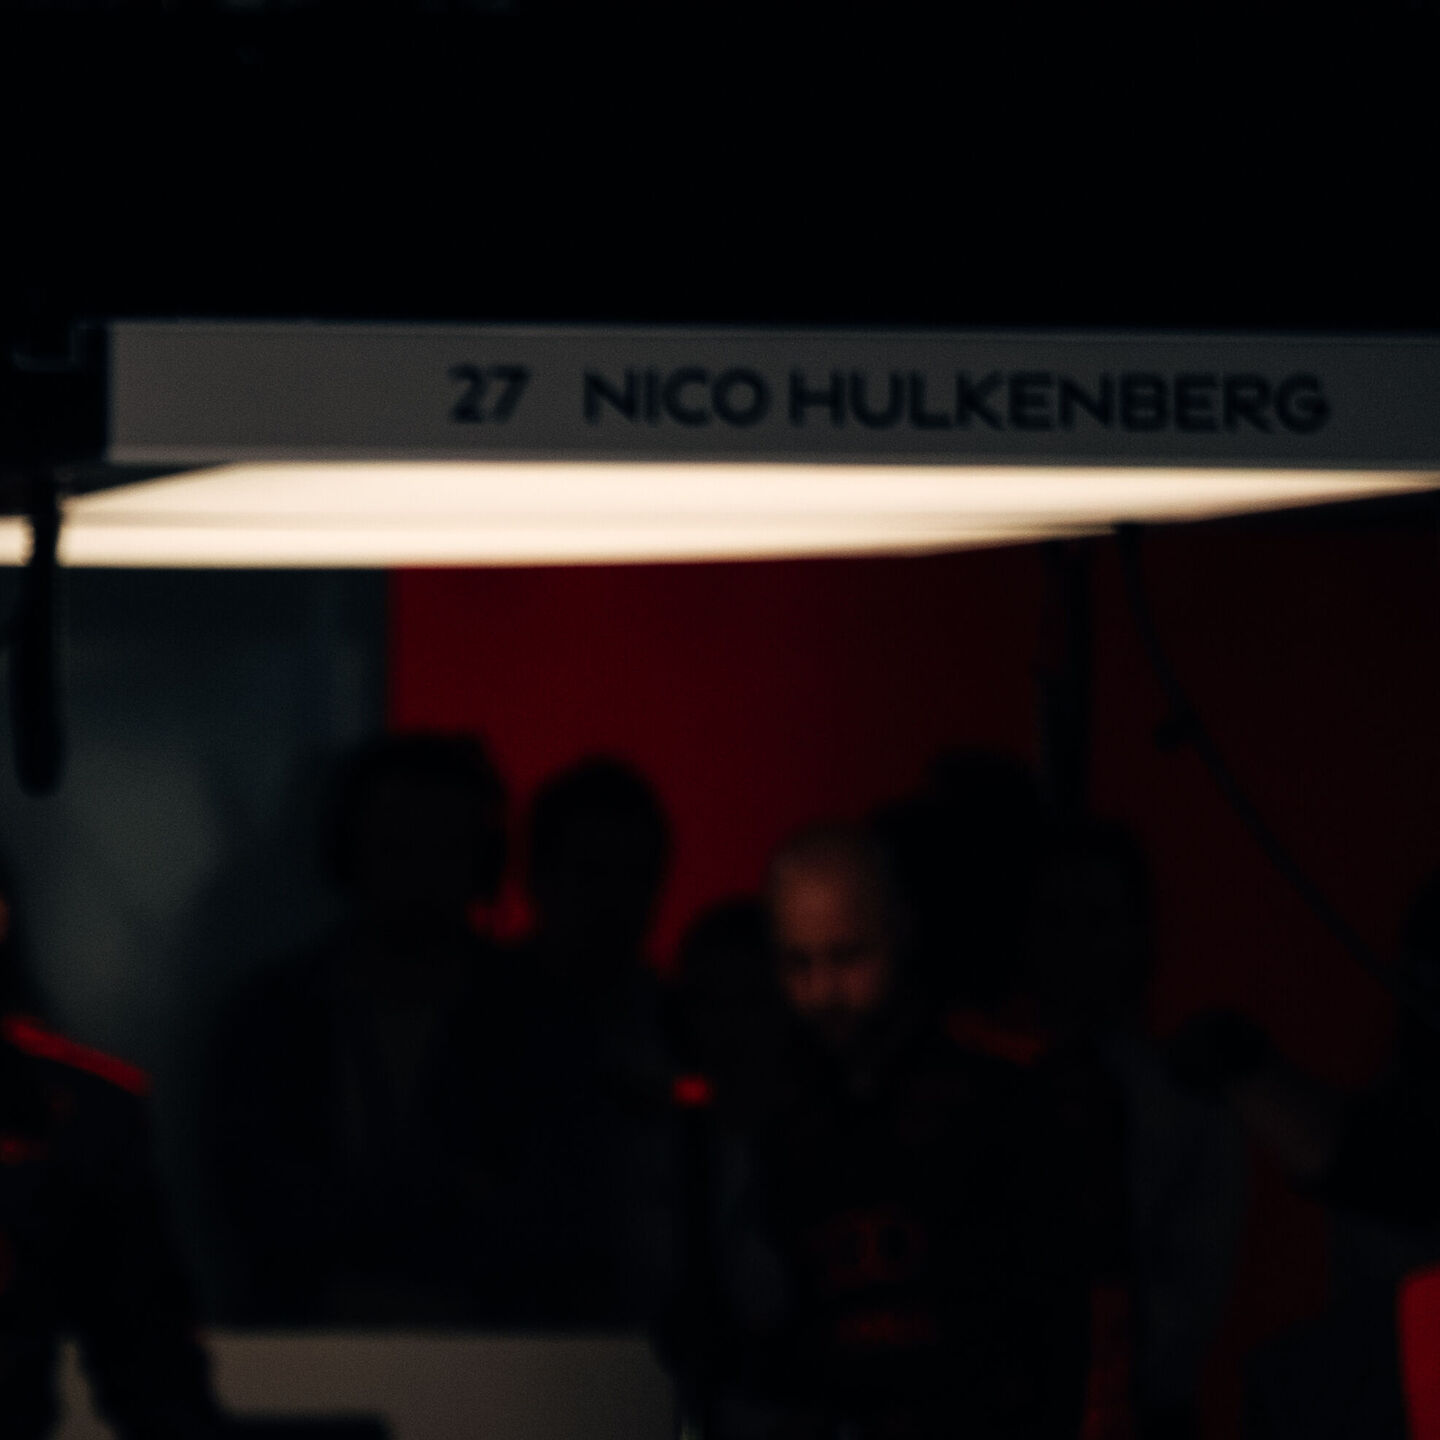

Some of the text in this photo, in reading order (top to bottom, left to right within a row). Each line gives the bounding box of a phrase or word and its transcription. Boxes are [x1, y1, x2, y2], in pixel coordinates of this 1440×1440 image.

[445, 363, 1332, 435] 27 NICO HULKENBERG
